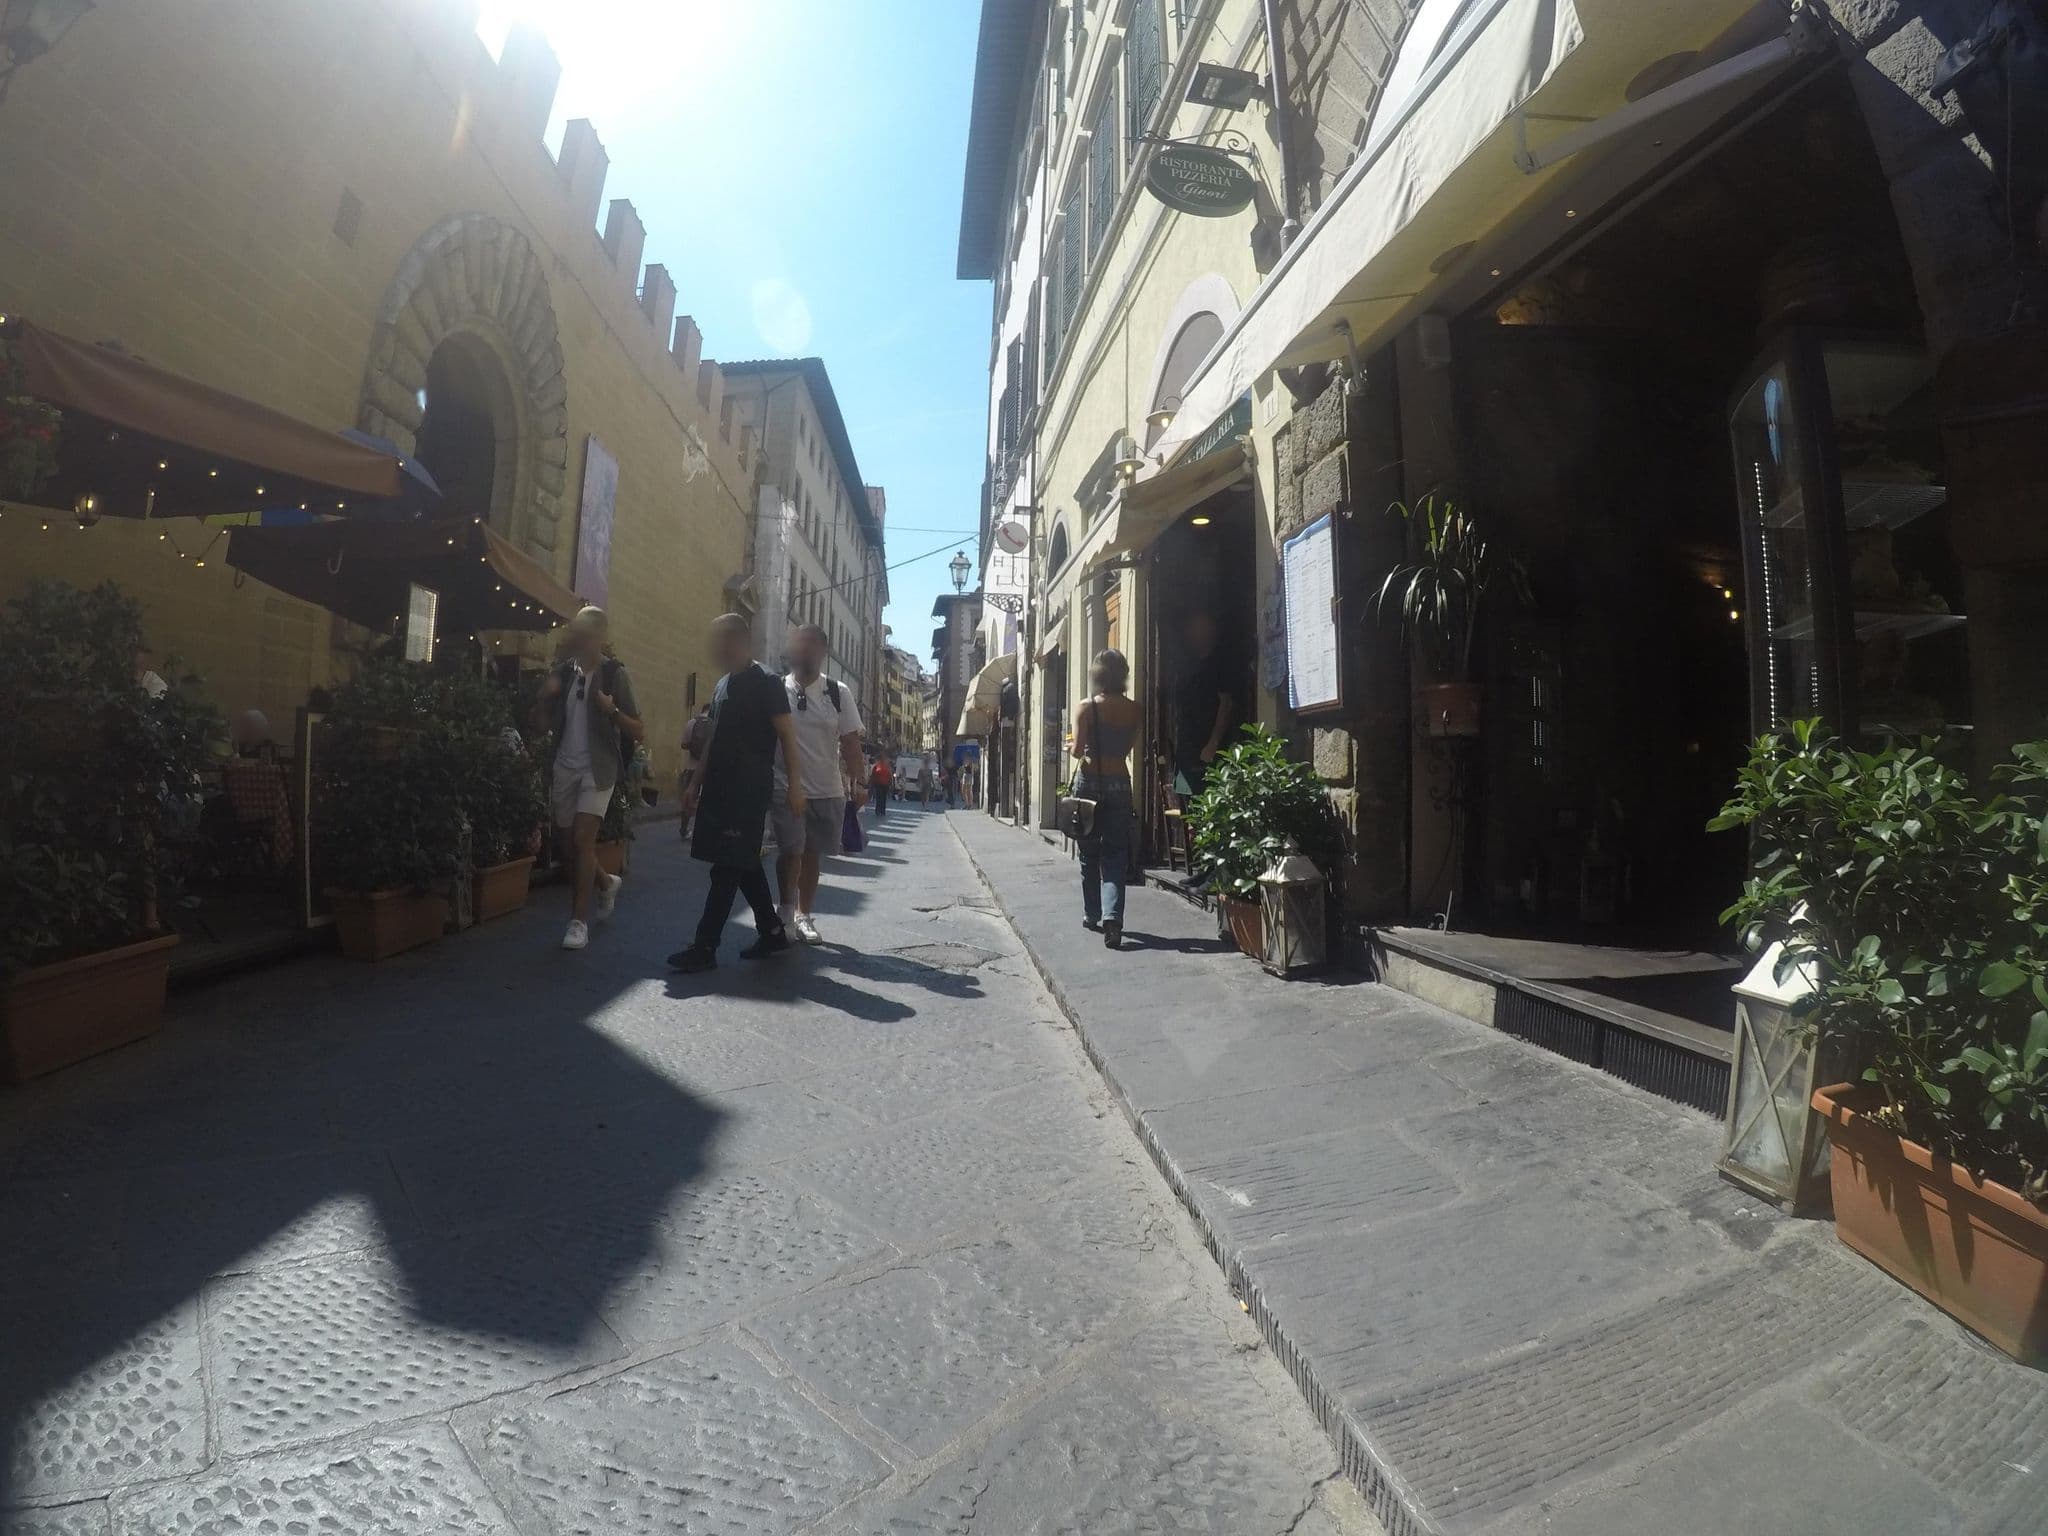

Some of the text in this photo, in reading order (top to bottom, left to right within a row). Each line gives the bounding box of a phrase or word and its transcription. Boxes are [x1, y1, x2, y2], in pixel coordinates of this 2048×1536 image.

[1160, 156, 1243, 178] RISTORANTE
[1171, 168, 1231, 186] PIZZERIA
[1175, 181, 1228, 199] Ginori
